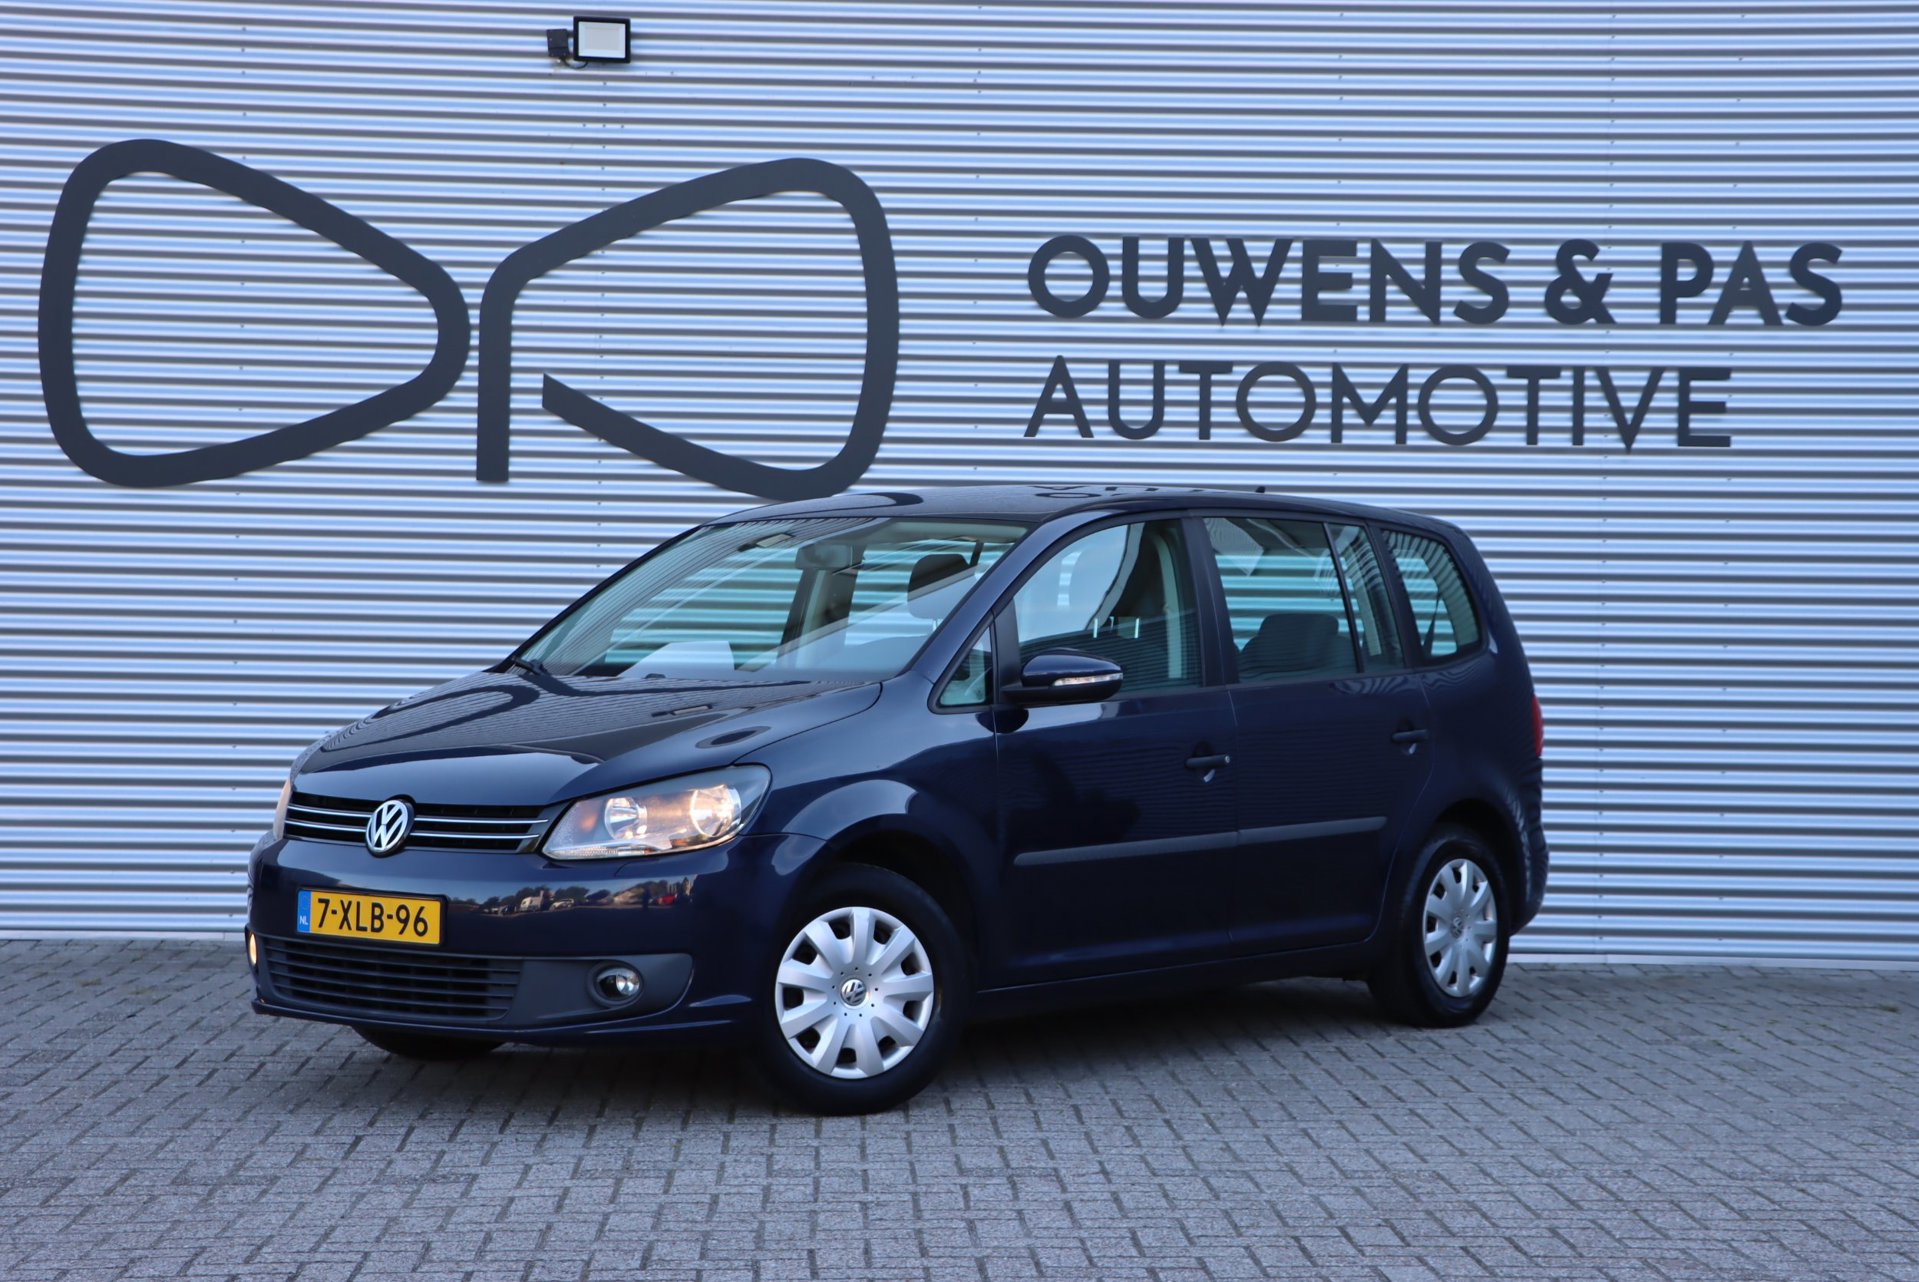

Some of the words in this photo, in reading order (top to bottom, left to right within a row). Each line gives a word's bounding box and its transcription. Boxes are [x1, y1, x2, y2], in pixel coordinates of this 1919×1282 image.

[1027, 235, 1510, 326] OUWENS
[1544, 239, 1616, 326] &
[1659, 240, 1843, 327] PAS
[1024, 355, 1732, 452] AUTOMOTIVE
[299, 915, 309, 925] NL
[318, 898, 428, 937] 7-XLB-96
